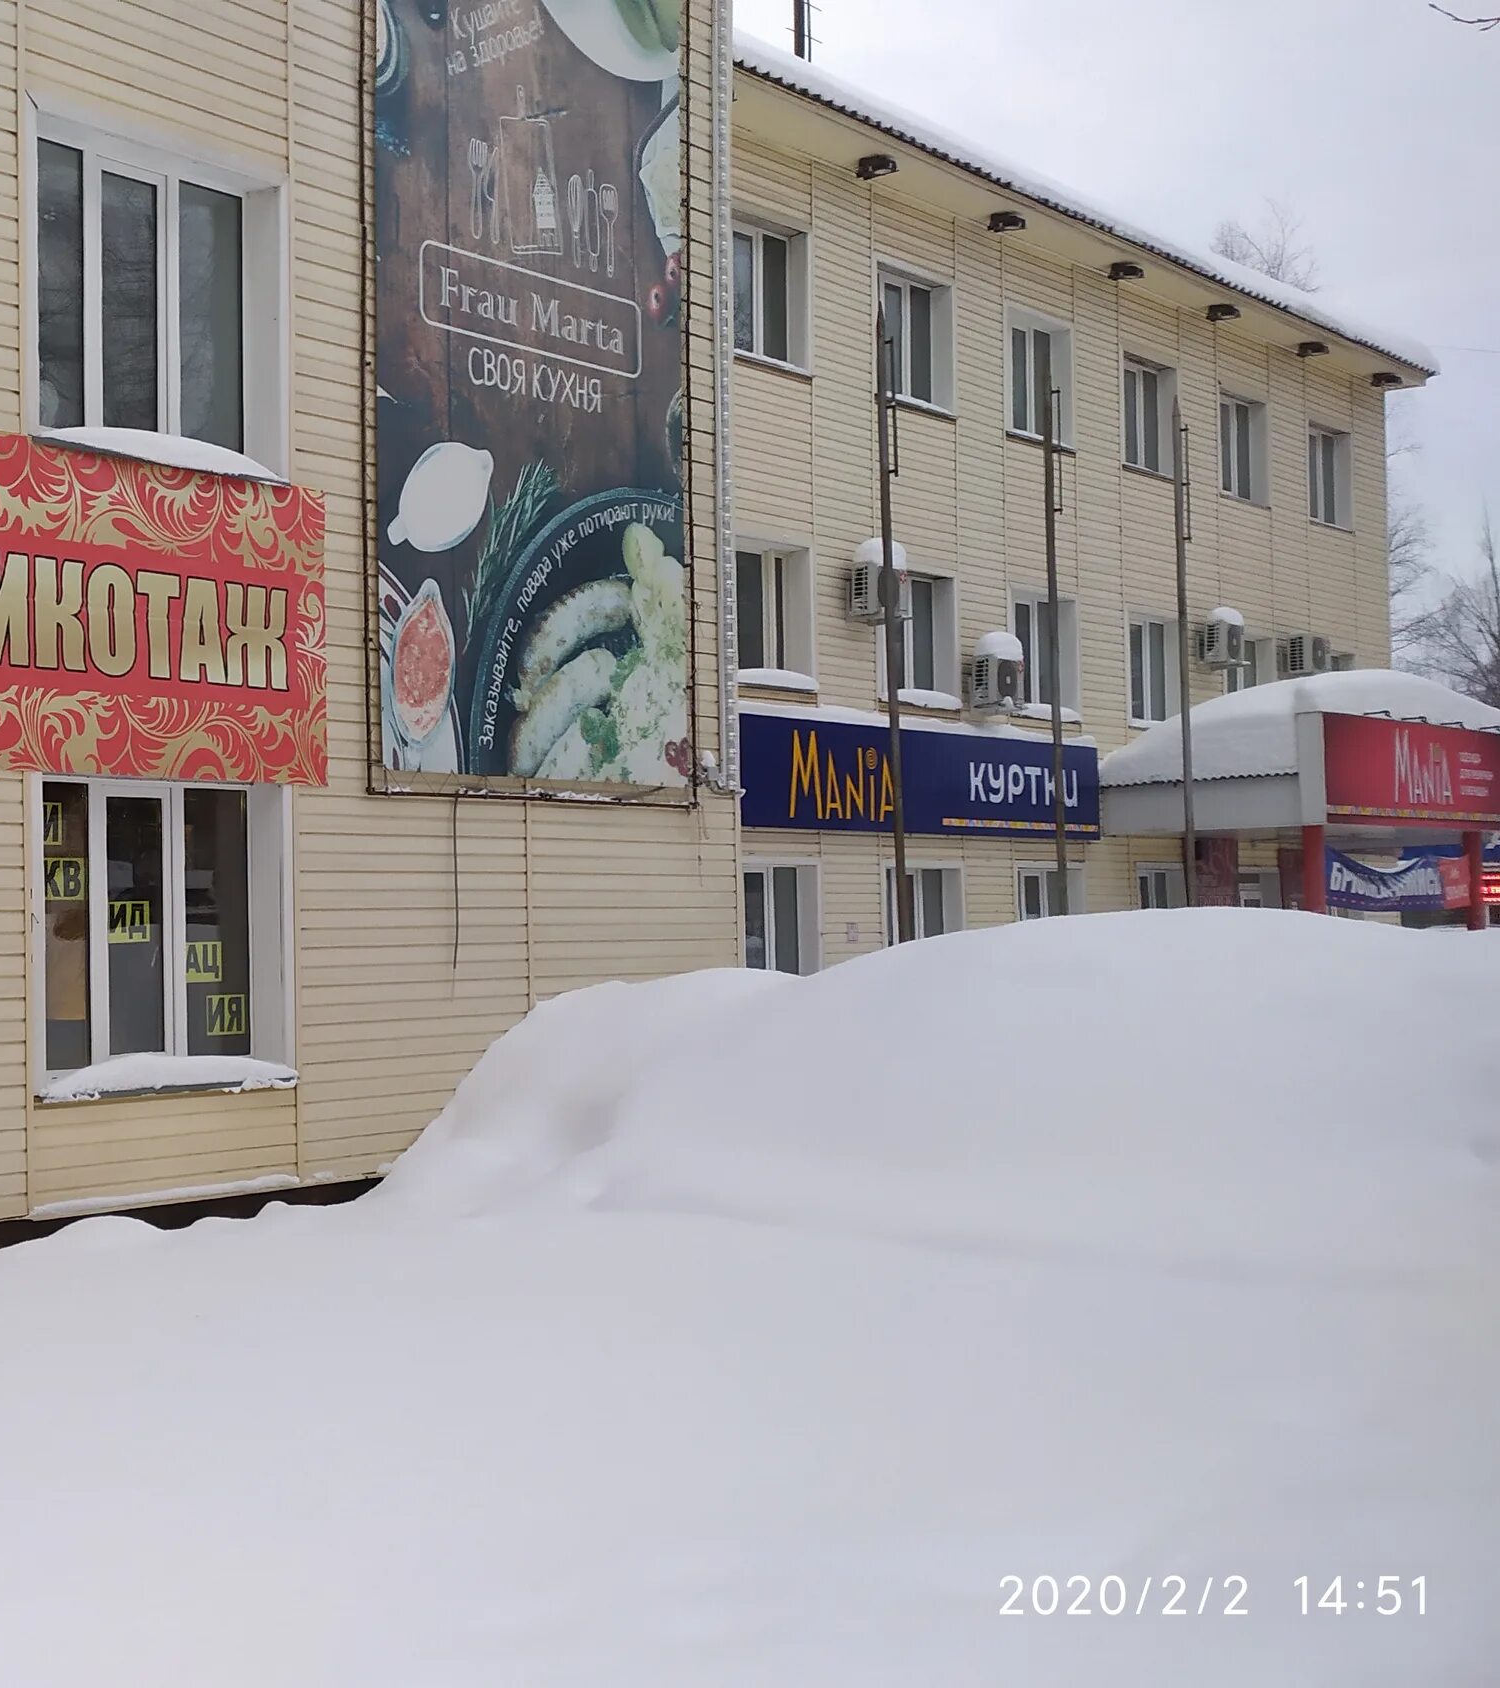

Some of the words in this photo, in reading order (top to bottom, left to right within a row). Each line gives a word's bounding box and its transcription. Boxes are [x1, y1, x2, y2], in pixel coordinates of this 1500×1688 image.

[445, 50, 468, 77] на
[469, 5, 545, 69] здоровье!
[439, 266, 519, 327] Frau
[530, 292, 625, 356] Marta
[468, 347, 526, 395] СВОЯ
[533, 363, 602, 413] КУХНЯ
[517, 555, 553, 613] повара
[551, 528, 578, 568] уже
[579, 503, 638, 539] потирают
[642, 503, 676, 527] руки!
[207, 997, 243, 1033] ИЯ
